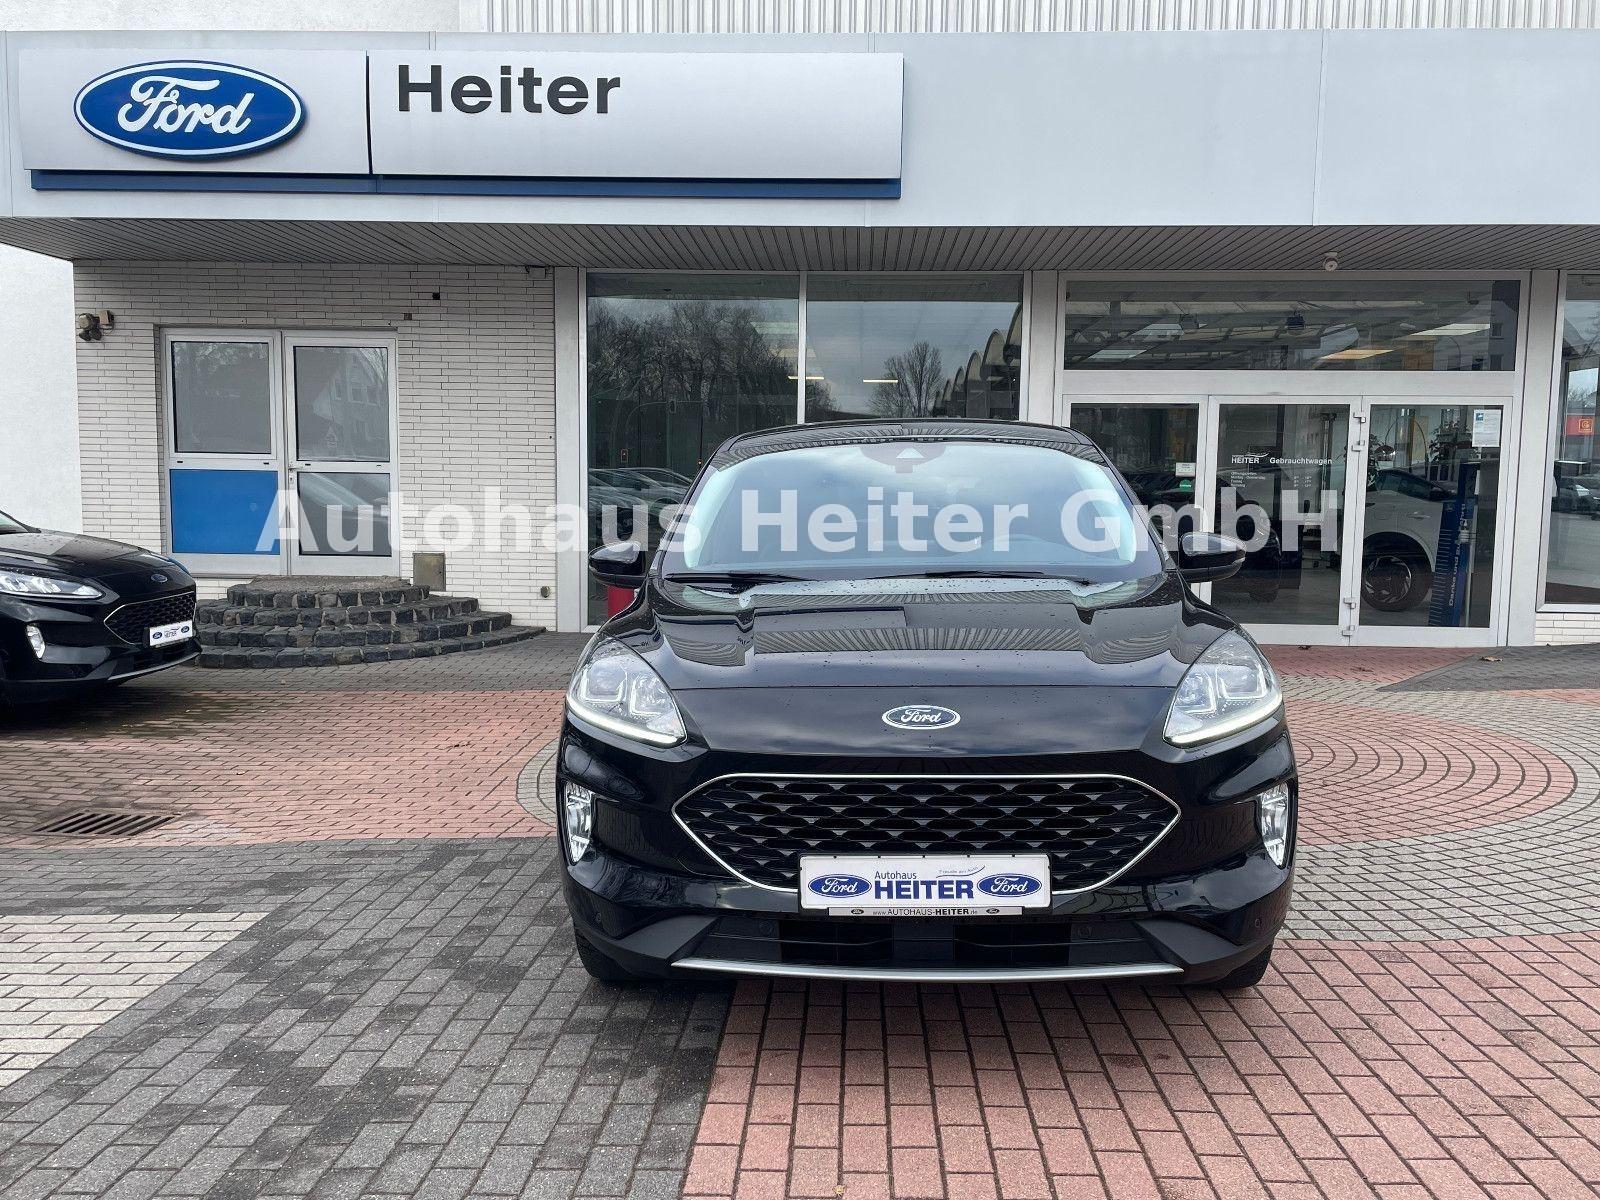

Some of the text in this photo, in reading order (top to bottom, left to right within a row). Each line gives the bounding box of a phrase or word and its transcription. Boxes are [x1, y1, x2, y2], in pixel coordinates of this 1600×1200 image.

[399, 64, 621, 114] Heiter
[117, 75, 254, 135] Ford
[1269, 457, 1333, 466] Gebrauchtwagen
[901, 709, 942, 722] Ford
[874, 870, 917, 880] Autohaus
[821, 876, 1029, 900] Ford HEITER Ford
